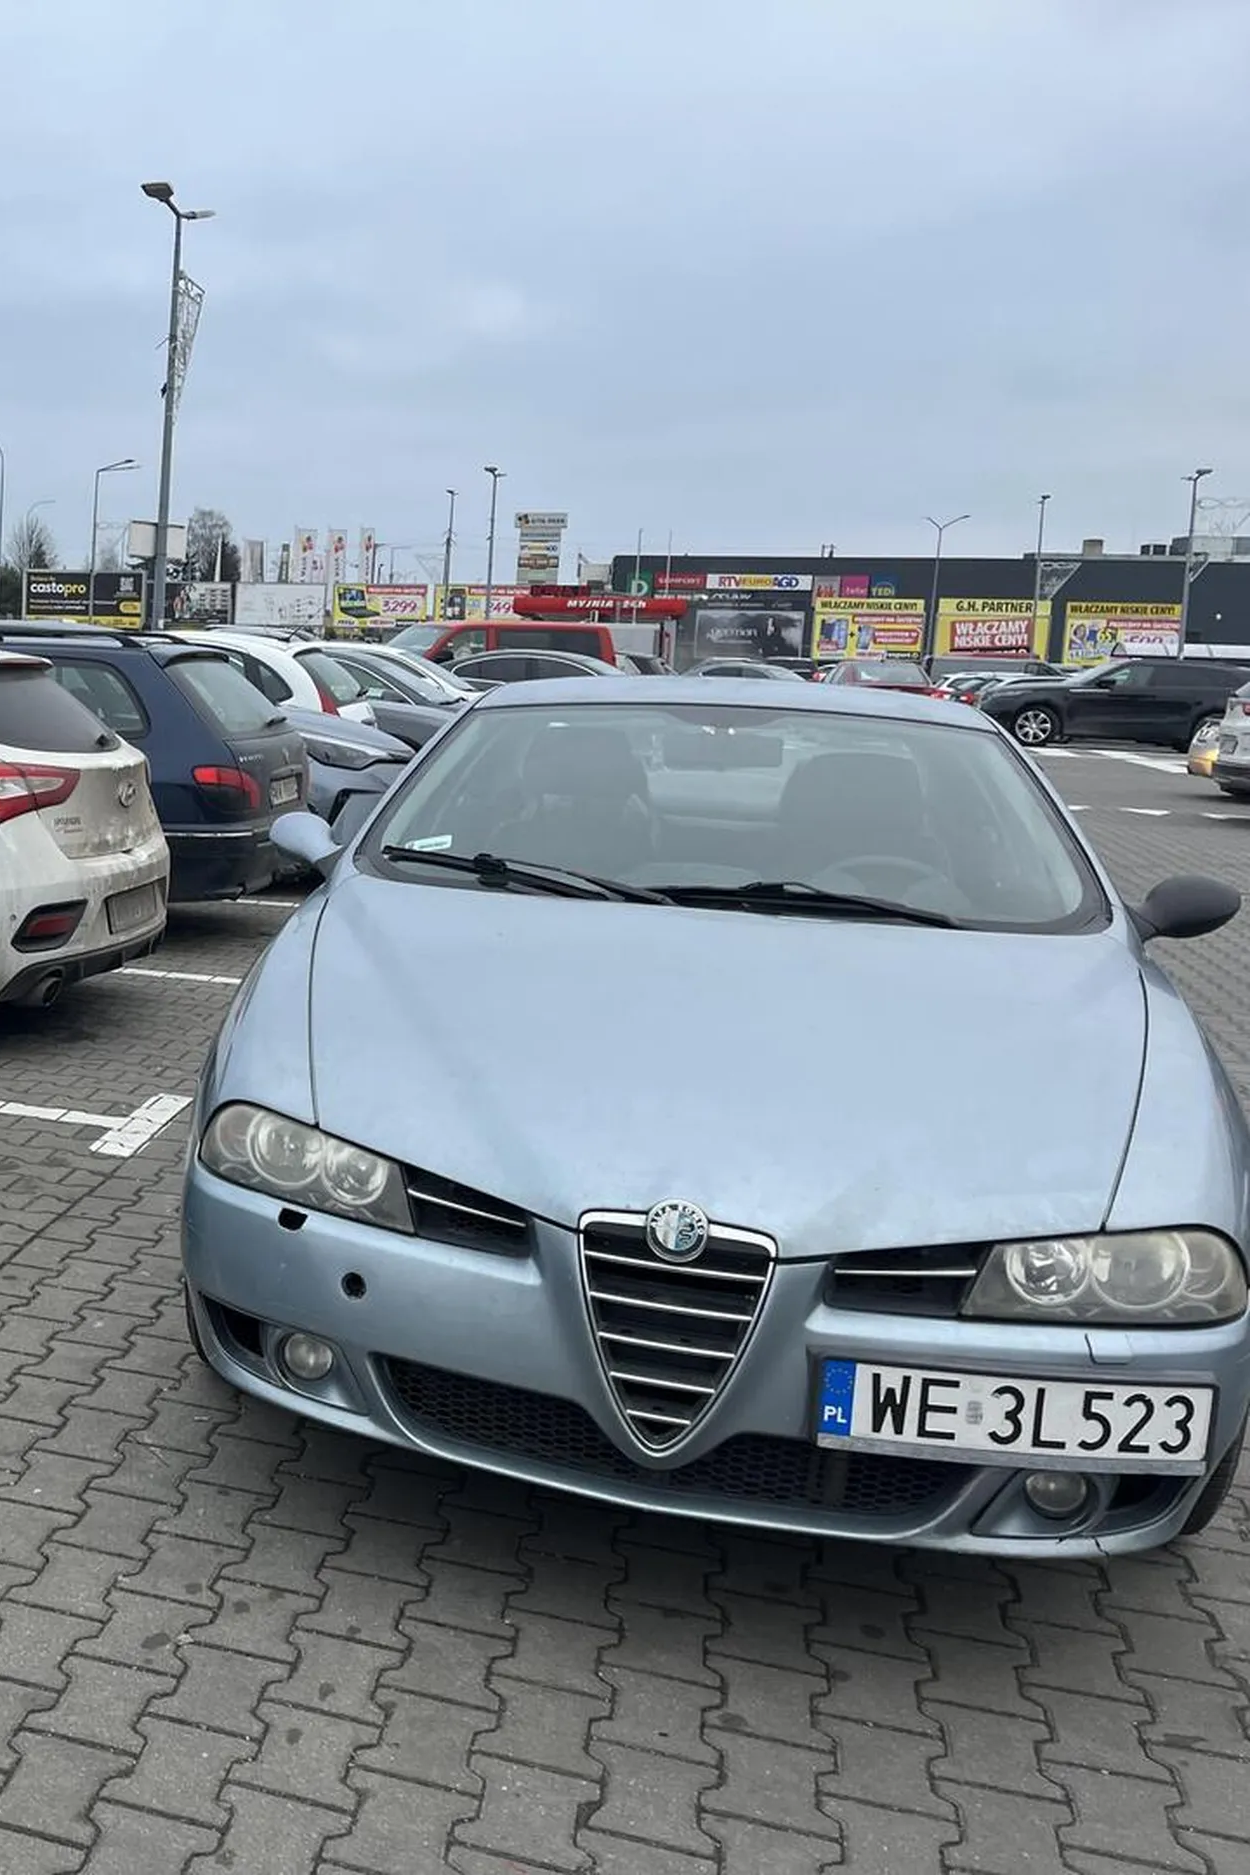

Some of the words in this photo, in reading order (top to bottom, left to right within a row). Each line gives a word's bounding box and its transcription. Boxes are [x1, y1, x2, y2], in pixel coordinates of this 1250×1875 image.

[30, 582, 87, 597] castopro
[718, 576, 741, 588] RTV
[955, 600, 979, 612] G.H.
[981, 601, 1033, 613] PARTNER
[954, 634, 993, 648] NISKIE
[993, 633, 1028, 647] CENY!
[823, 1404, 848, 1424] PL
[871, 1372, 961, 1441] WE
[987, 1385, 1196, 1455] 3L523
